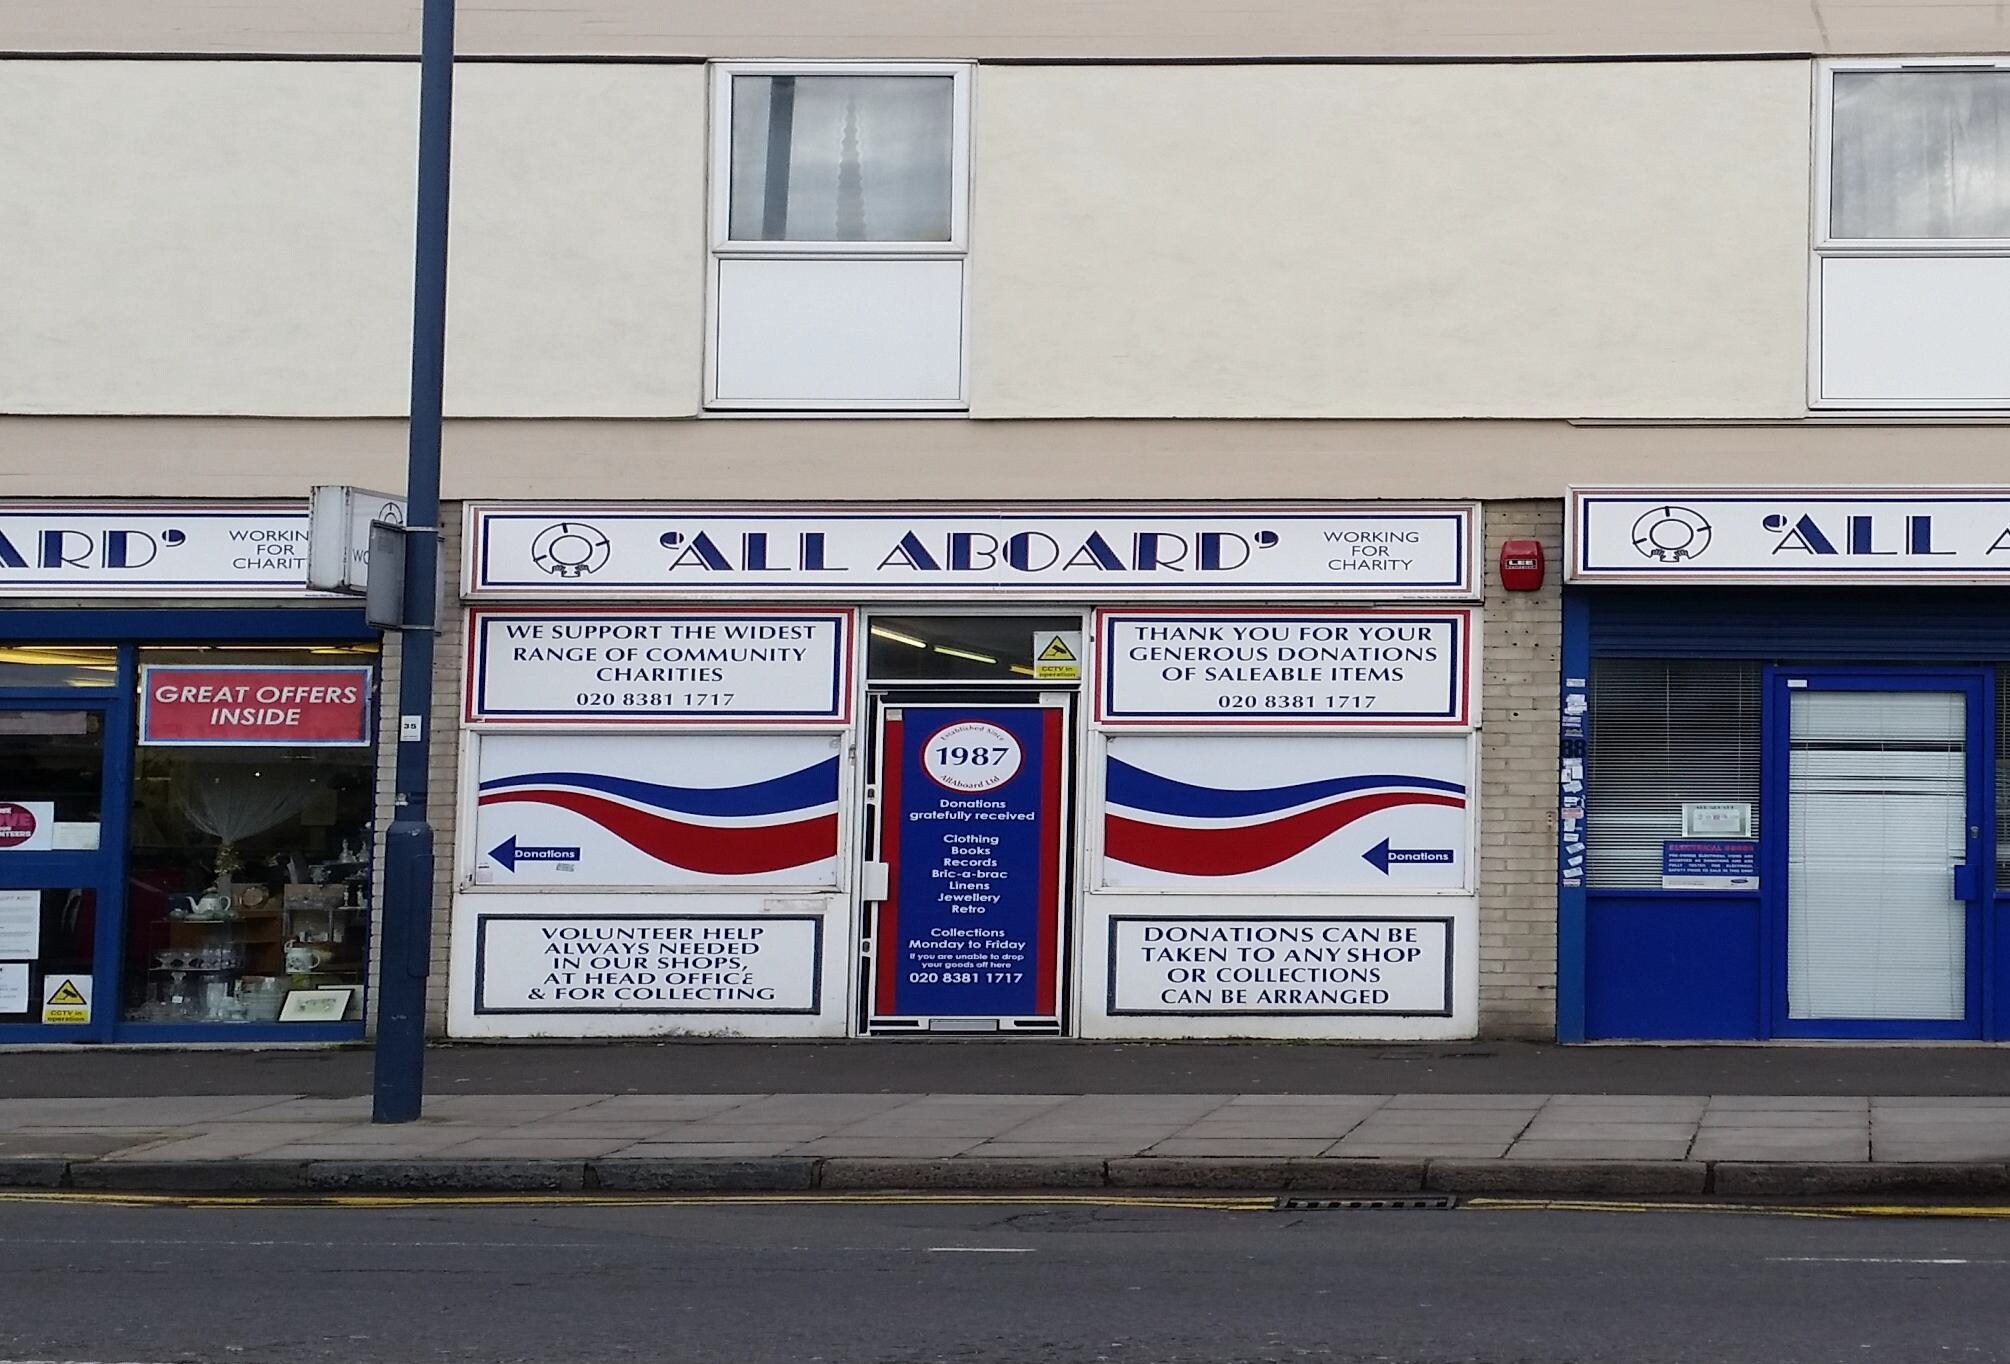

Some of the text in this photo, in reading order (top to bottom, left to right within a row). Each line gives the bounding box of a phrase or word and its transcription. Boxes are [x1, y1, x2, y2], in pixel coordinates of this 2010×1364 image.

[229, 531, 308, 541] WORKIN
[1324, 532, 1418, 542] WORKING
[257, 544, 294, 555] FOR
[1352, 546, 1389, 556] FOR
[233, 558, 304, 569] CHARIT
[1329, 560, 1413, 570] CHARITY
[507, 625, 816, 639] WE SUPPORT THE WIDEST
[1135, 627, 1431, 641] THANK YOU FOR YOUR
[514, 648, 806, 661] RANGE OF COMMUNITY
[1130, 647, 1437, 661] GENEROUS DONATIONS
[597, 668, 722, 681] CHARITIES
[1162, 667, 1403, 681] OF SALEABLE ITEMS
[156, 686, 357, 703] GREAT OFFERS
[577, 693, 734, 705] 020 8381 1717
[1219, 696, 1376, 708] 020 8381 1717
[211, 708, 300, 725] INSIDE
[940, 725, 985, 741] Established
[936, 747, 1009, 765] 1987
[940, 799, 1006, 808] Donations
[910, 811, 1034, 821] gratefully received
[944, 834, 999, 845] Clothing
[514, 849, 576, 859] Donations
[1388, 851, 1449, 861] Donations
[944, 858, 997, 866] Records
[932, 870, 1008, 878] Bric-a-brac
[950, 881, 989, 890] Linens
[938, 893, 1000, 903] Jewellery
[952, 905, 985, 913] Retro
[542, 928, 763, 940] VOLUNTEER HELP
[931, 928, 1005, 937] Collections
[1145, 927, 1416, 942] DONATIONS CAN BE
[545, 943, 759, 954] ALWAYS NEEDED
[909, 940, 1025, 950] Monday to Friday
[1002, 953, 1024, 961] drop
[1141, 948, 1420, 962] TAKEN TO ANY SHOP
[555, 957, 747, 971] IN OUR SHOPS,
[945, 961, 974, 969] goods
[544, 973, 752, 984] AT HEAD OFFICE
[910, 973, 1022, 983] 020 8381 1717
[1168, 968, 1380, 983] OR COLLECTIONS
[528, 988, 774, 1000] & FOR COLLECTING
[1162, 989, 1388, 1004] CAN BE ARRANGED
